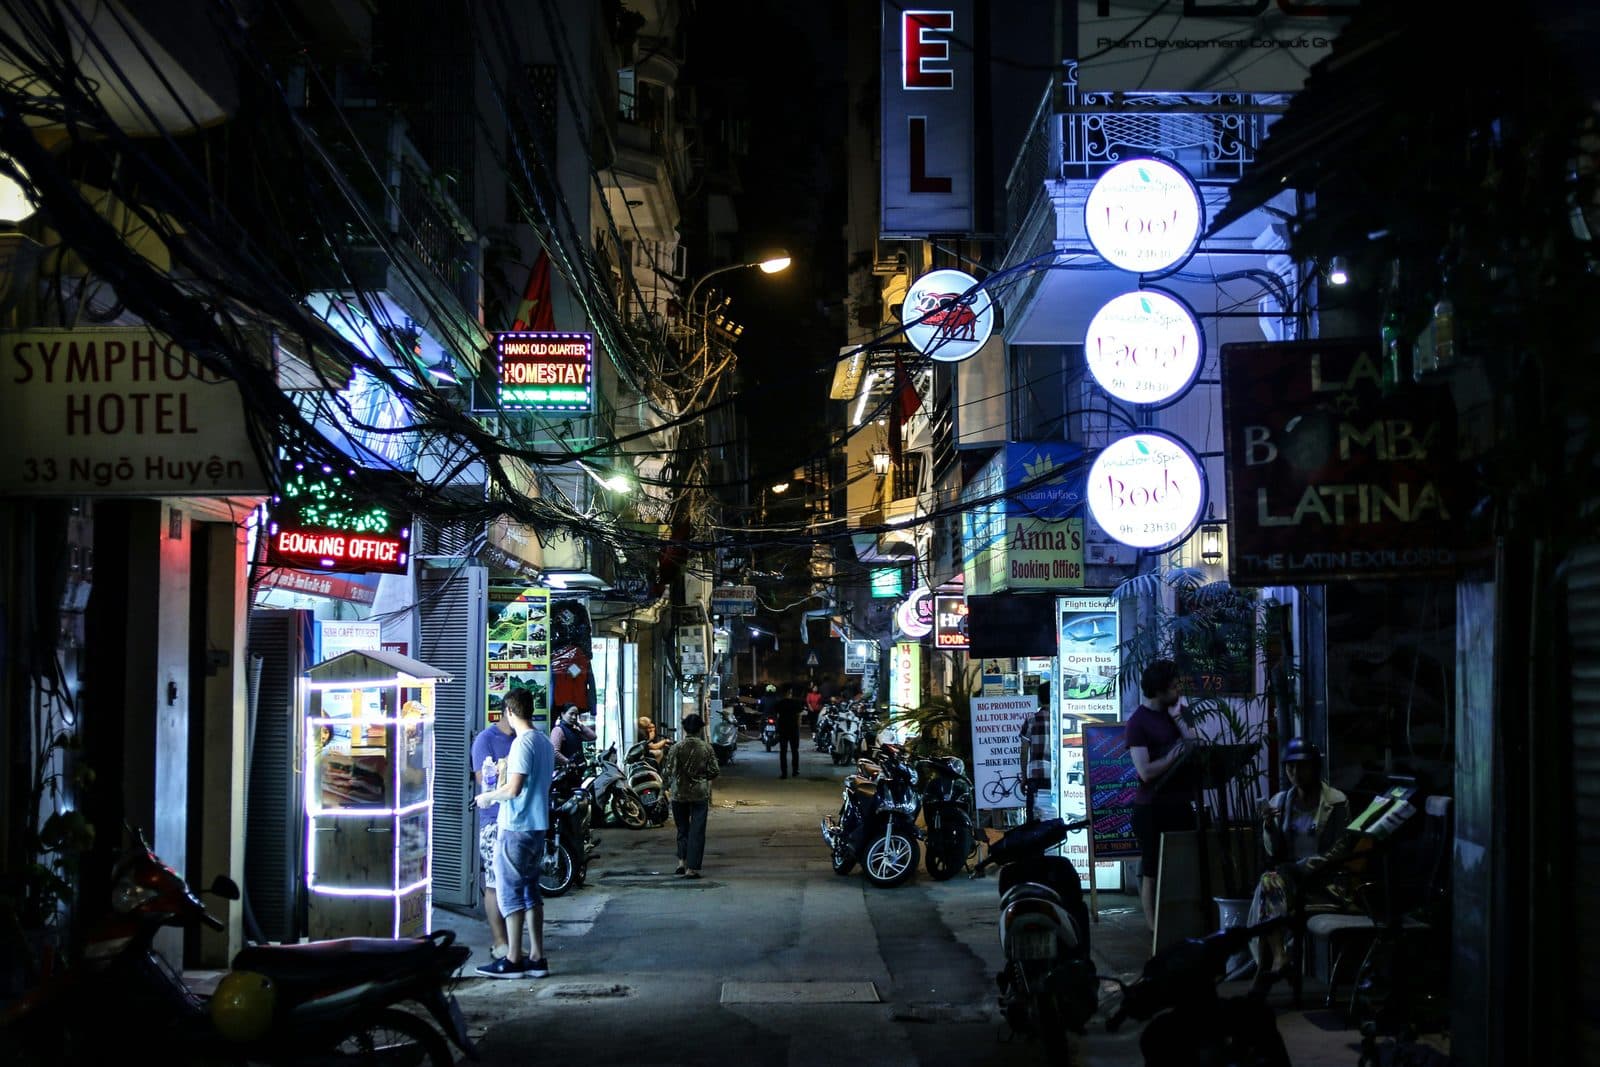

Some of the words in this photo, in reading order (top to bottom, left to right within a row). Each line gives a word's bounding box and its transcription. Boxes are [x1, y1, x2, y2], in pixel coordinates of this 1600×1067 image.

[1097, 37, 1141, 49] Pham
[1144, 37, 1248, 50] Development
[1251, 37, 1309, 49] Consult
[504, 343, 530, 355] HANOI
[530, 343, 547, 355] OLD
[547, 343, 586, 356] QUARTER
[504, 362, 586, 384] HOMESTAY
[1311, 352, 1382, 393] LA
[66, 393, 198, 435] HOTEL
[23, 459, 57, 482] 33
[70, 457, 134, 487] Ngõ
[146, 456, 244, 486] Huyện
[1256, 480, 1452, 527] LATINA
[1011, 521, 1081, 551] Anna's
[348, 538, 399, 561] OFFICE
[1241, 553, 1283, 570] THE
[1288, 552, 1347, 570] LATIN
[1011, 559, 1050, 581] Booking
[1053, 559, 1080, 579] Office
[1065, 600, 1087, 609] Flight
[1068, 655, 1092, 664] Open
[1095, 655, 1112, 663] bus
[977, 702, 989, 711] BIG
[990, 700, 1031, 710] PROMOTION
[1067, 703, 1087, 711] Train
[1088, 703, 1114, 711] tickets
[976, 713, 989, 722] ALL
[990, 713, 1009, 721] TOUR
[975, 724, 1000, 733] MONEY
[978, 735, 1010, 745] LAUNDRY
[990, 747, 1002, 756] SIM
